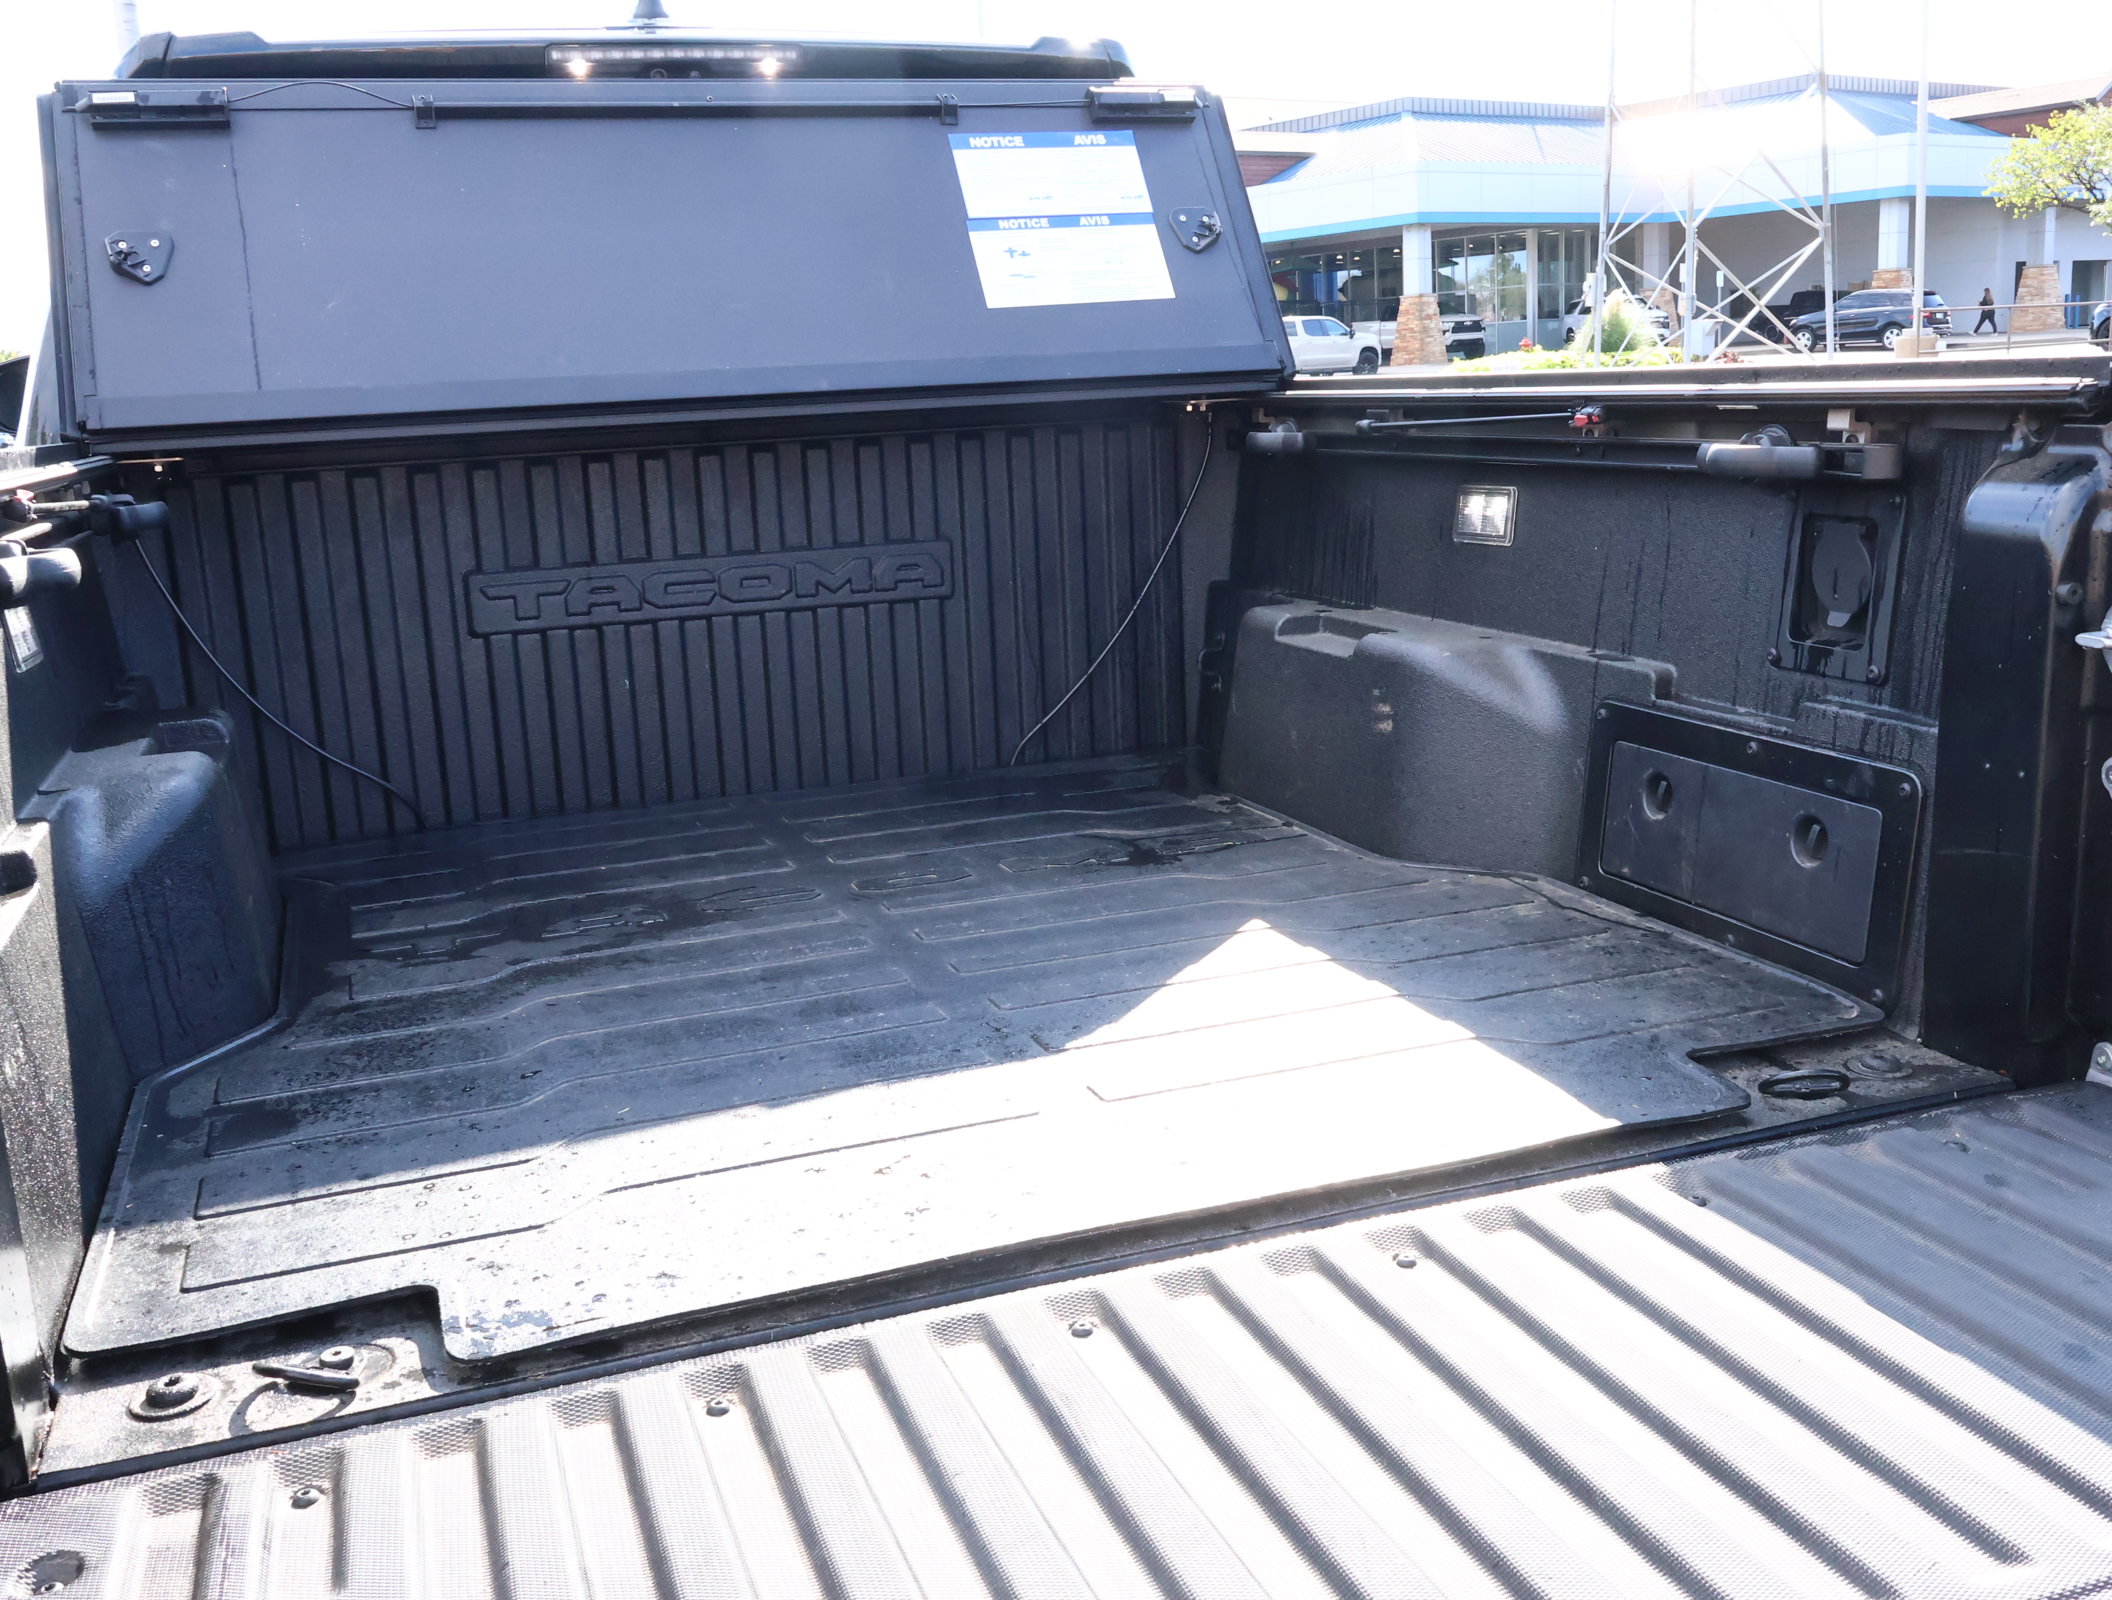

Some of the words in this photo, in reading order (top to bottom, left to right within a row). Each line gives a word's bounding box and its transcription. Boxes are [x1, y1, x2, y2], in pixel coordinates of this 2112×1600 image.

[969, 135, 1024, 148] NOTICE
[1073, 134, 1106, 145] AVIS
[998, 217, 1050, 229] NOTICE
[1079, 215, 1110, 226] AVIS
[479, 553, 945, 622] TACOMA
